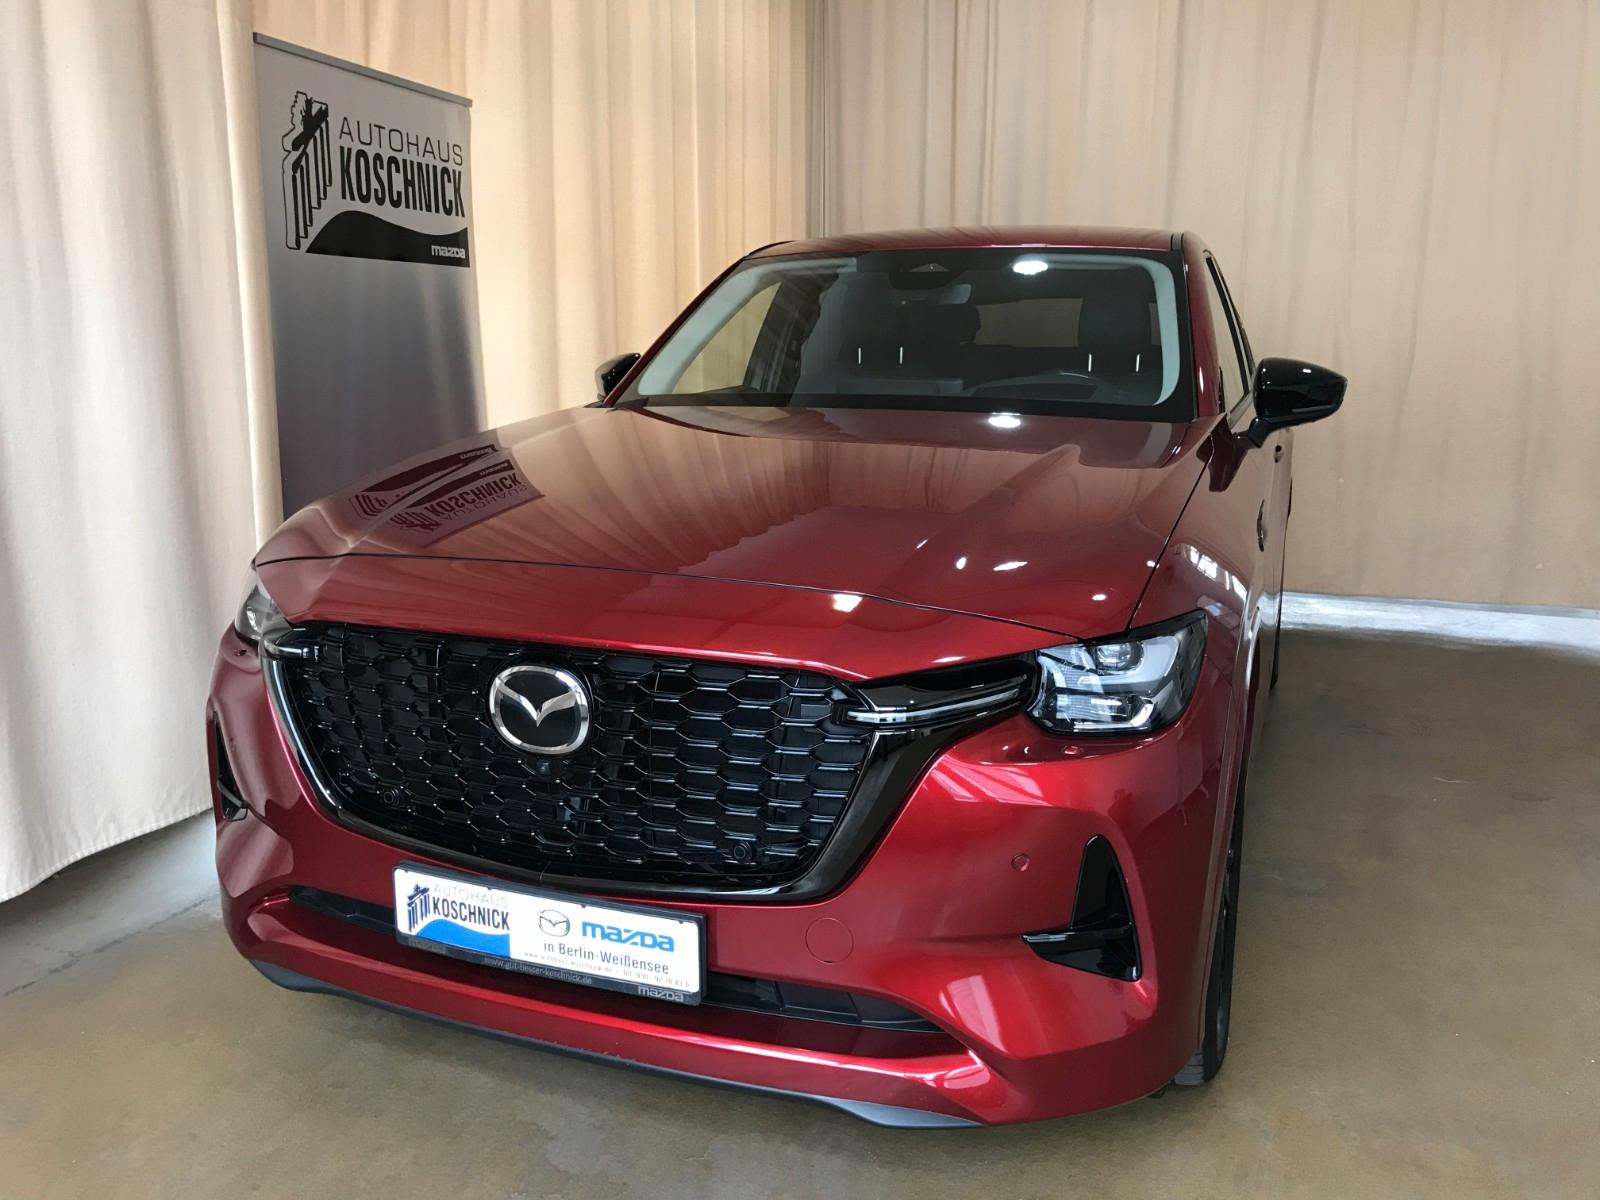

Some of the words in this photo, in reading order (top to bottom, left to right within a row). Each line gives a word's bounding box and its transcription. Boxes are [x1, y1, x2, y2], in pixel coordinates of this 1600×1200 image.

[339, 116, 463, 167] AUTOHAUS
[339, 145, 466, 218] KOSCHNICK
[431, 245, 466, 259] mazda
[433, 883, 508, 909] AUTOHAUS
[432, 896, 510, 931] KOSCHNICK
[581, 921, 675, 952] mazda
[543, 942, 554, 953] in
[559, 943, 669, 975] Berlin-Weißensee
[637, 985, 684, 1003] mazda
